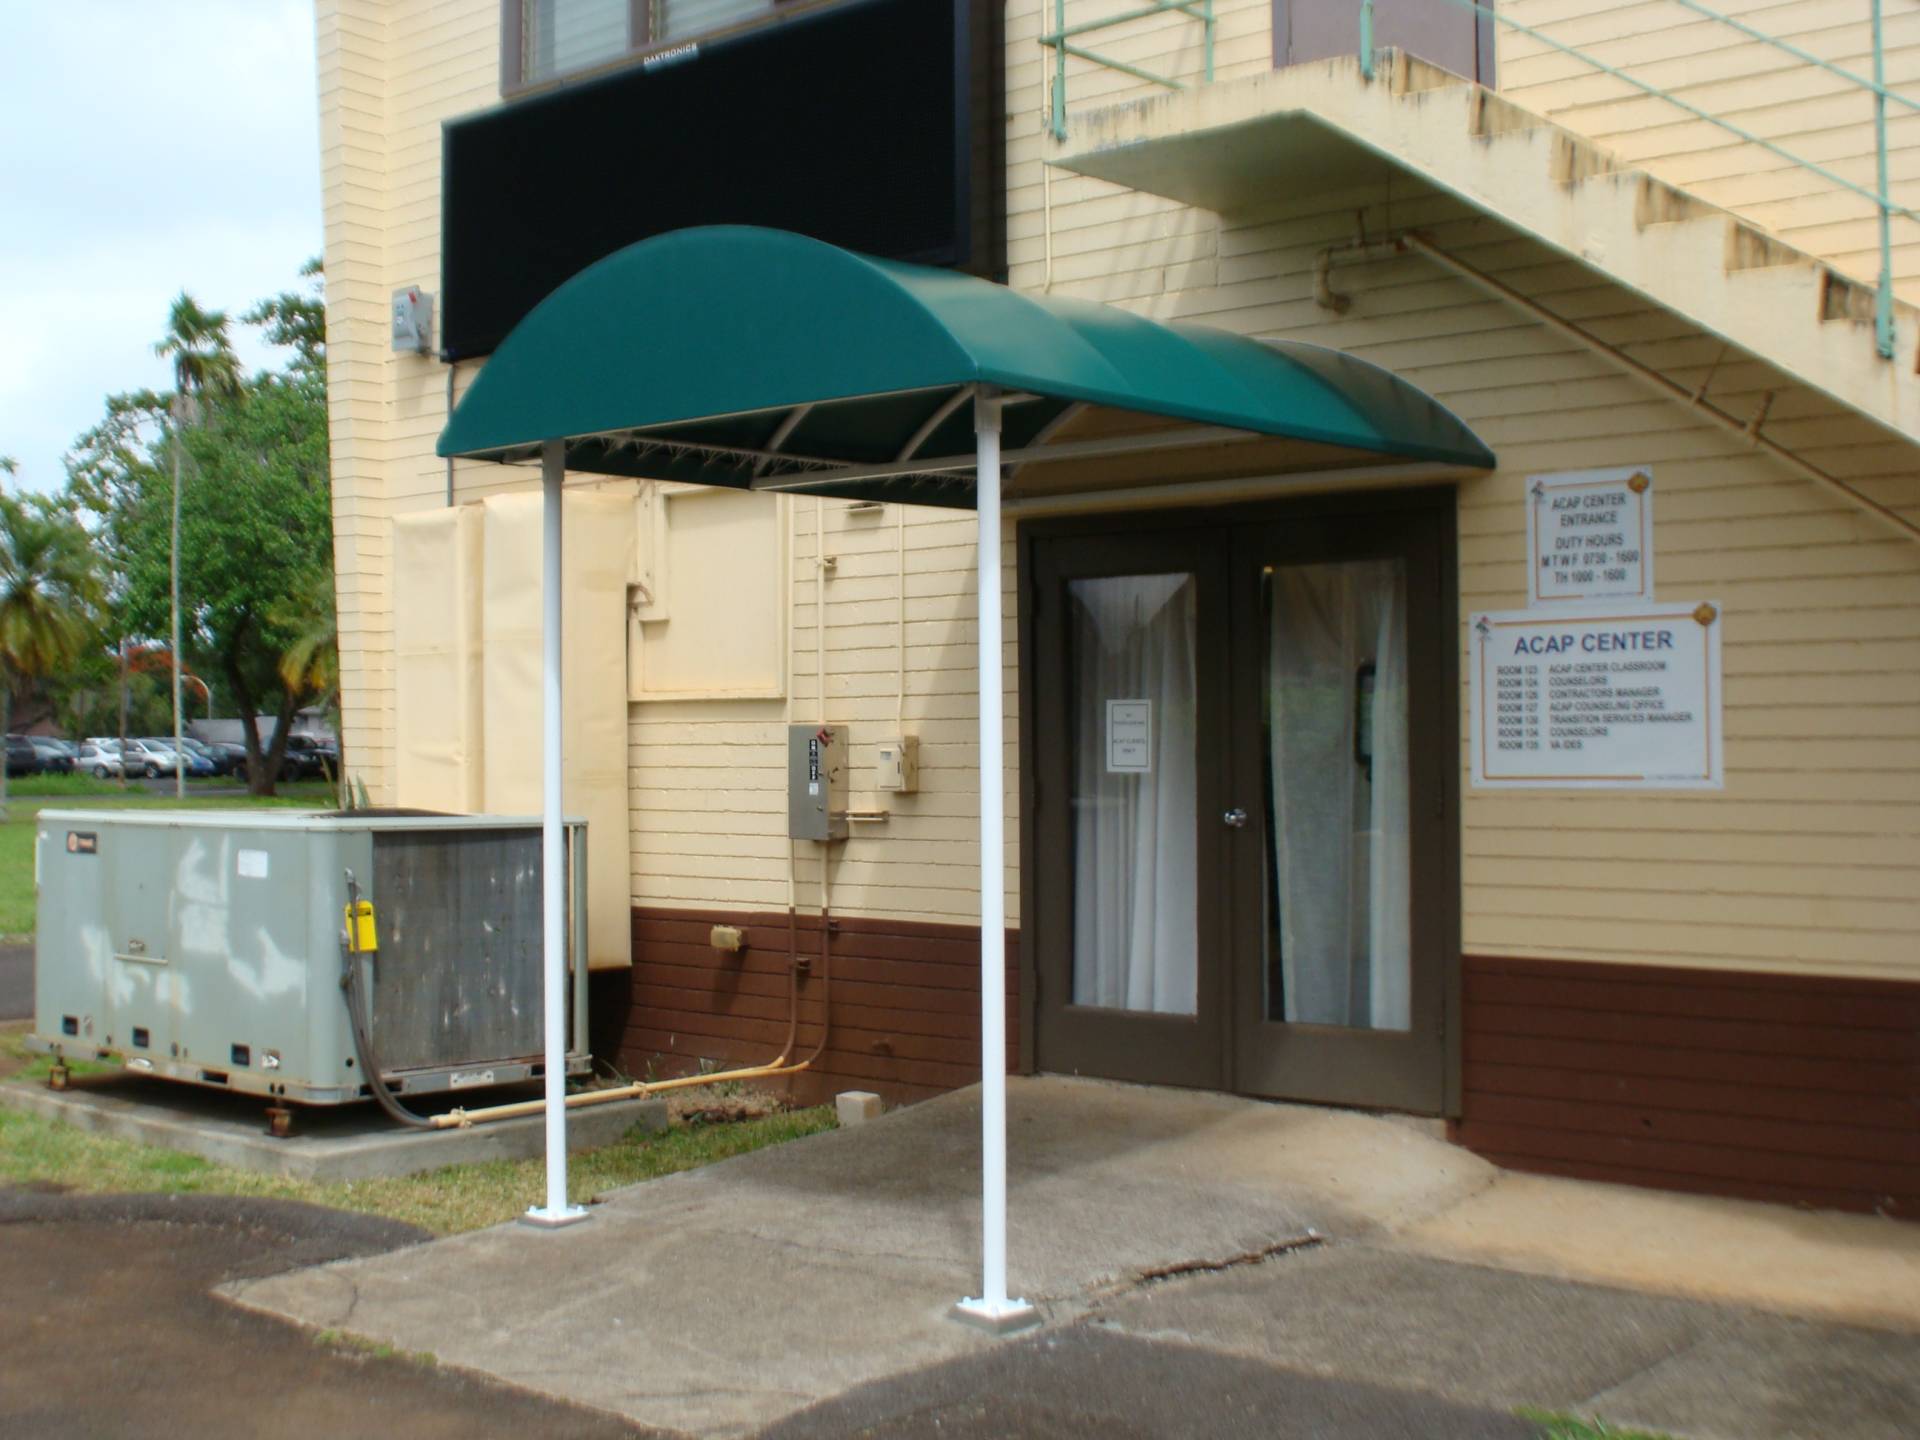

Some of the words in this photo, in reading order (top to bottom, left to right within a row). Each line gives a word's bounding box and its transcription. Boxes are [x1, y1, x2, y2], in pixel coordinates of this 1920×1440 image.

[1552, 496, 1580, 509] ACAP
[1583, 493, 1626, 508] CENTER
[1560, 511, 1617, 527] ENTRANCE
[1555, 536, 1582, 549] DUTY
[1585, 533, 1624, 547] HOURS
[1514, 635, 1574, 655] ACAP
[1581, 630, 1673, 652] CENTER
[1497, 665, 1522, 675] ROOM
[1497, 678, 1522, 688] ROOM
[1497, 690, 1522, 700] ROOM
[1498, 703, 1522, 713] ROOM
[1498, 715, 1522, 725] ROOM
[1498, 727, 1522, 737] ROOM
[1499, 740, 1522, 750] ROOM
